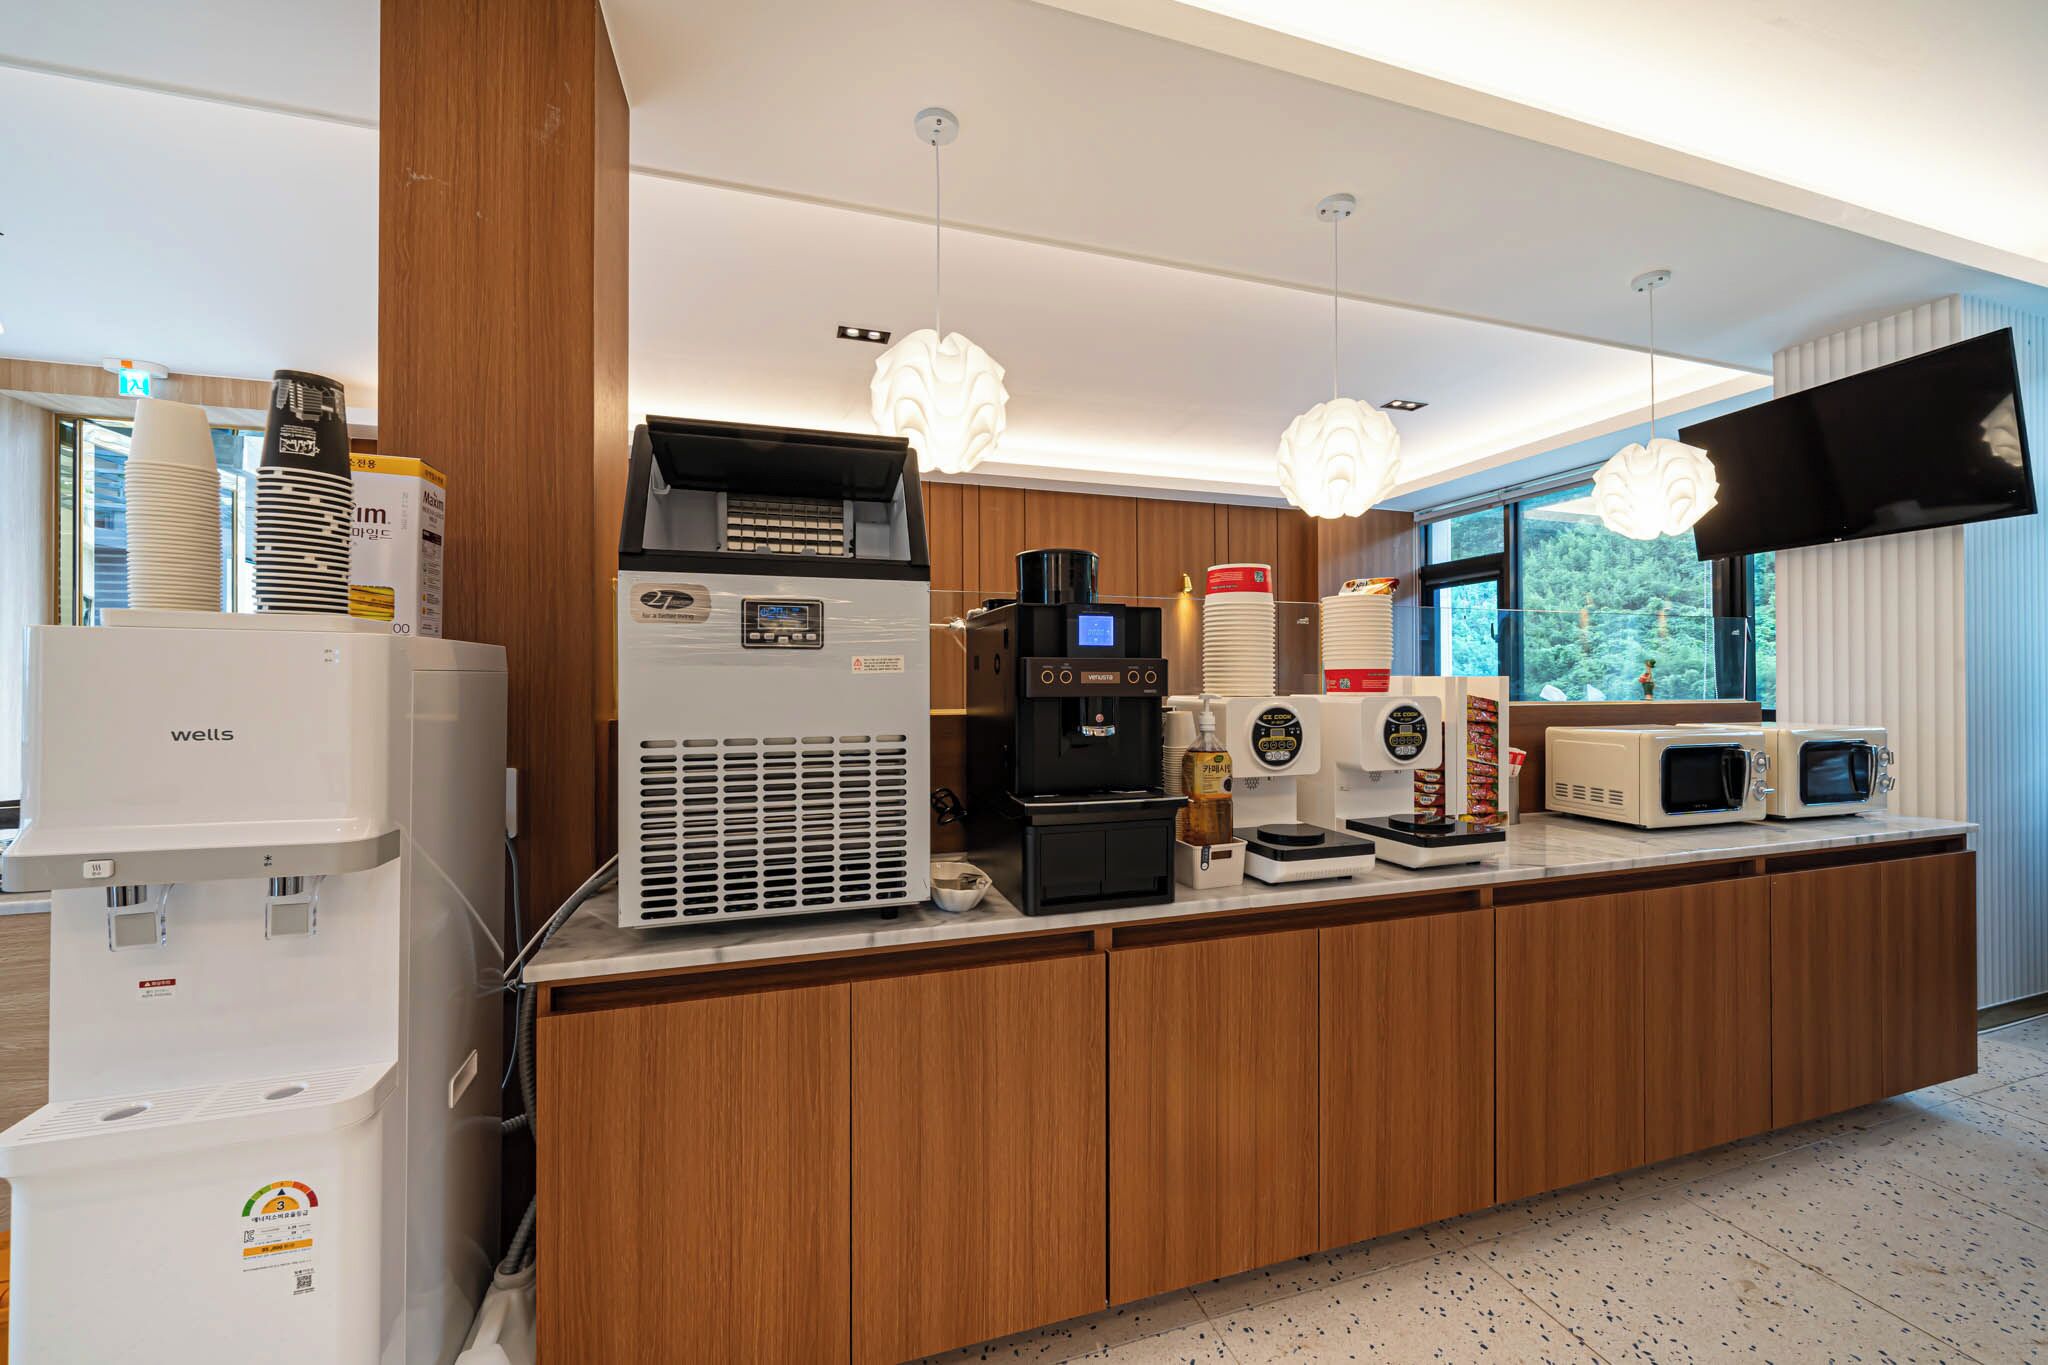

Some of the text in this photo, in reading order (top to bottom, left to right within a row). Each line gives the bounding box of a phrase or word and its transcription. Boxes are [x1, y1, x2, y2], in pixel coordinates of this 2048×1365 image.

[422, 490, 444, 511] Maxim
[352, 527, 393, 541] 마일드
[170, 728, 234, 741] wells
[276, 1201, 285, 1211] 3
